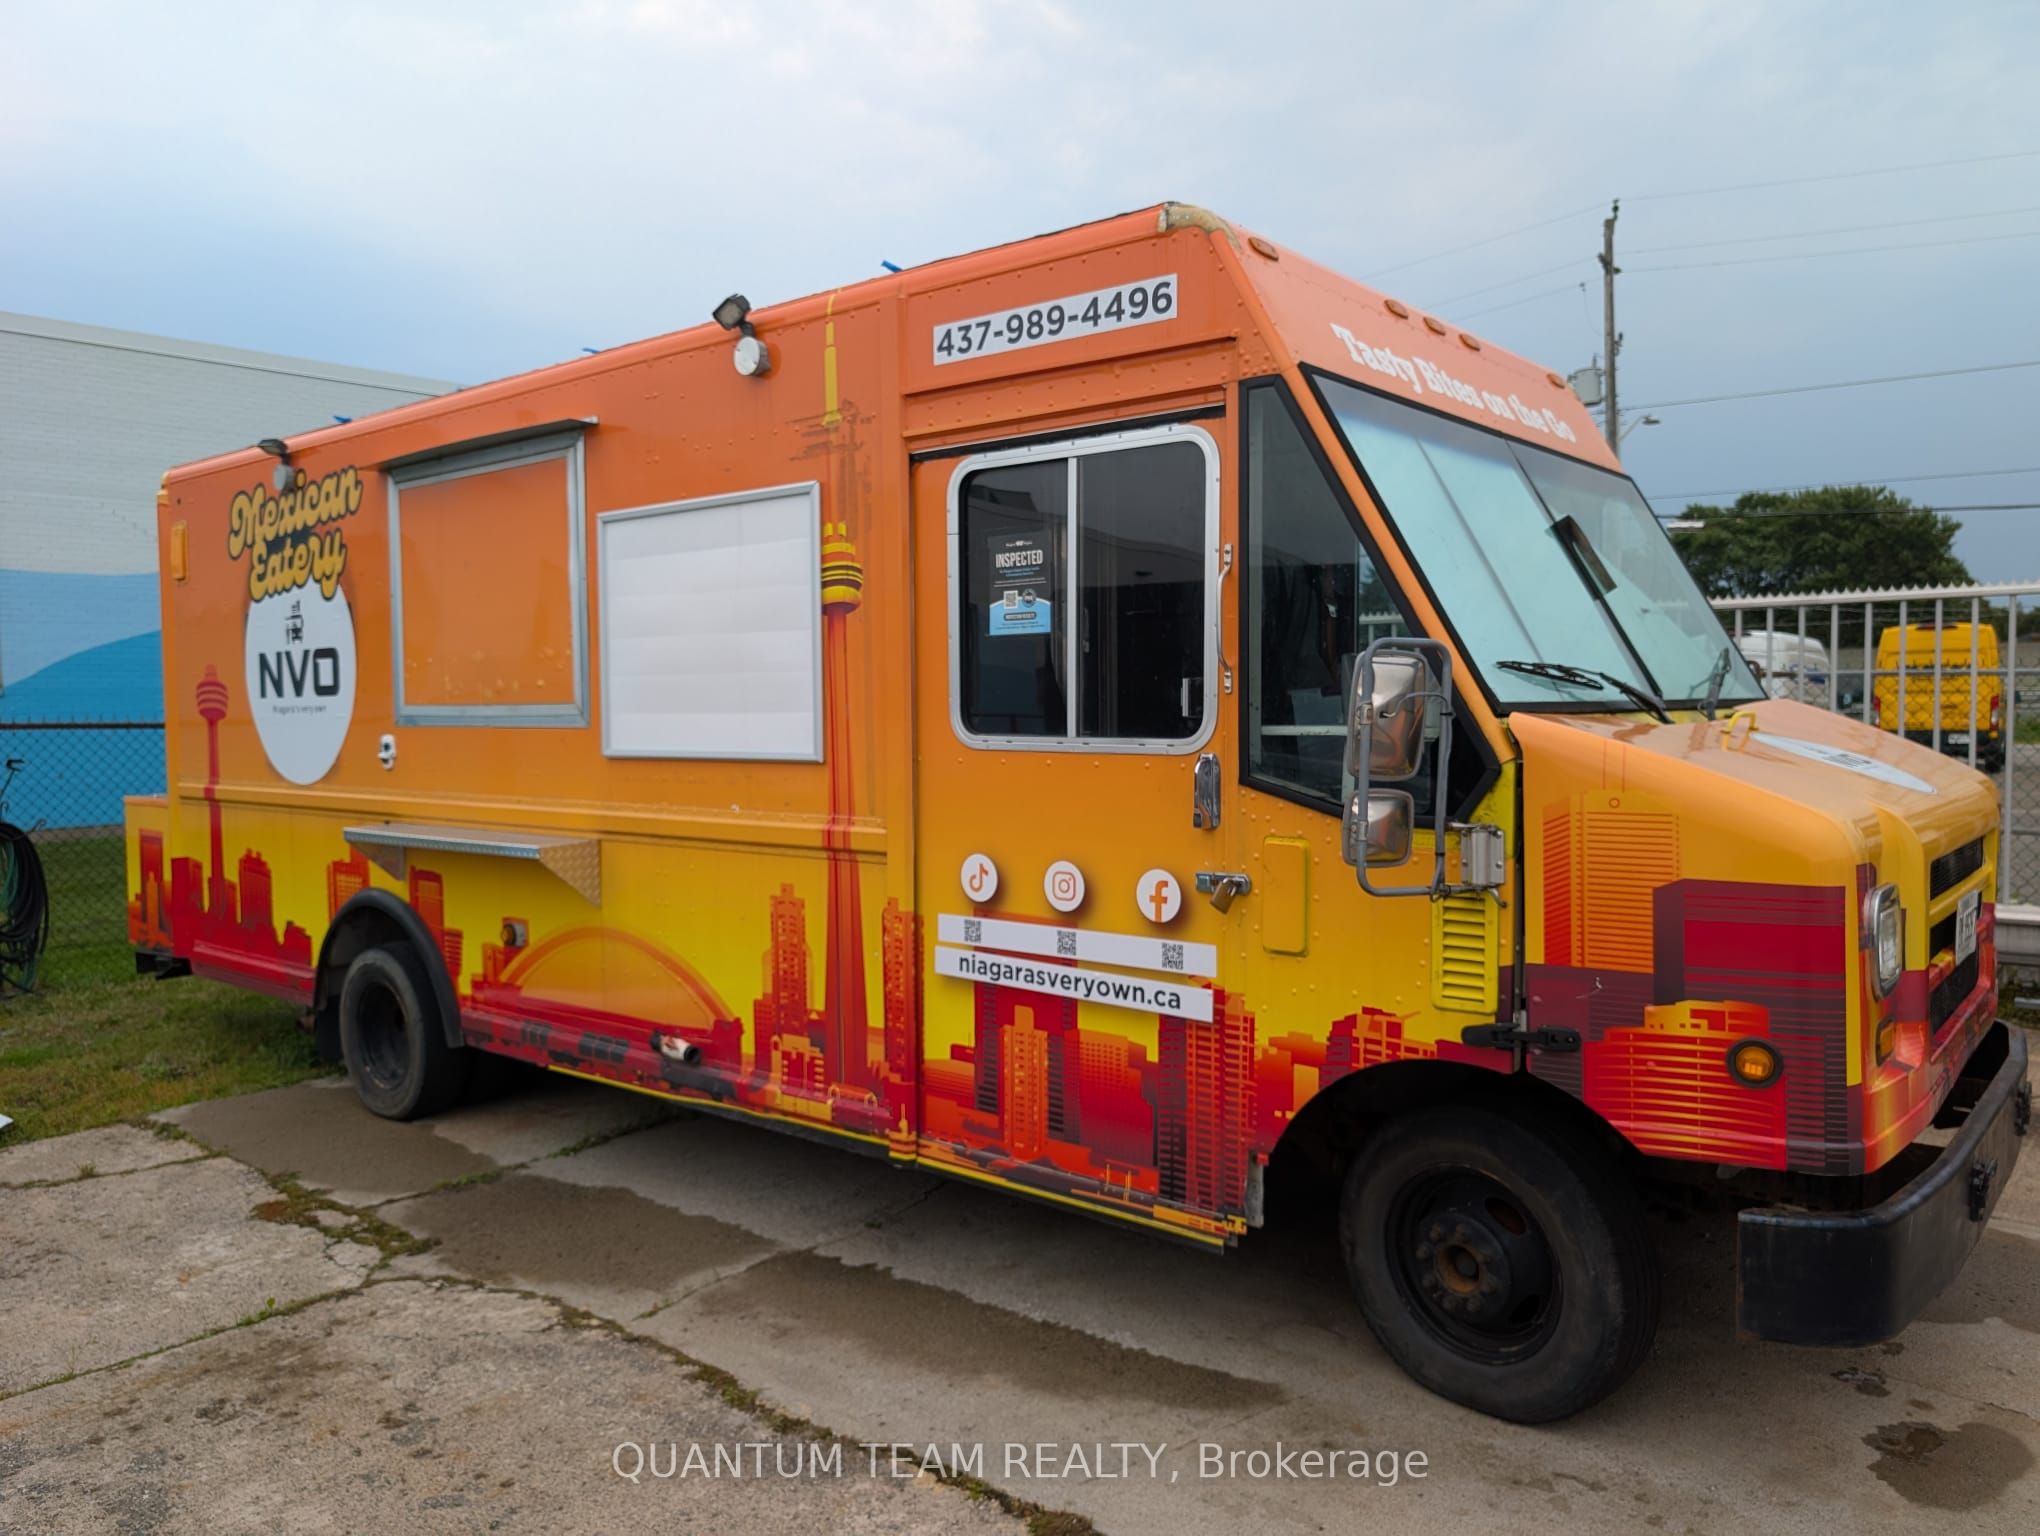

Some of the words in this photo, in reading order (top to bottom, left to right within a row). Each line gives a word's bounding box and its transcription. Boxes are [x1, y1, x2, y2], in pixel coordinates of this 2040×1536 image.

[937, 281, 1173, 356] 437-989-4496
[1329, 322, 1423, 394] Tasty
[1412, 356, 1485, 409] Bites
[1481, 391, 1517, 421] on
[1507, 393, 1550, 433] the
[229, 466, 363, 560] Mexican
[250, 529, 347, 602] Eatery
[995, 550, 1044, 568] INSPECTED
[259, 648, 340, 699] NVO
[958, 954, 1181, 1010] niagarasveryown.ca
